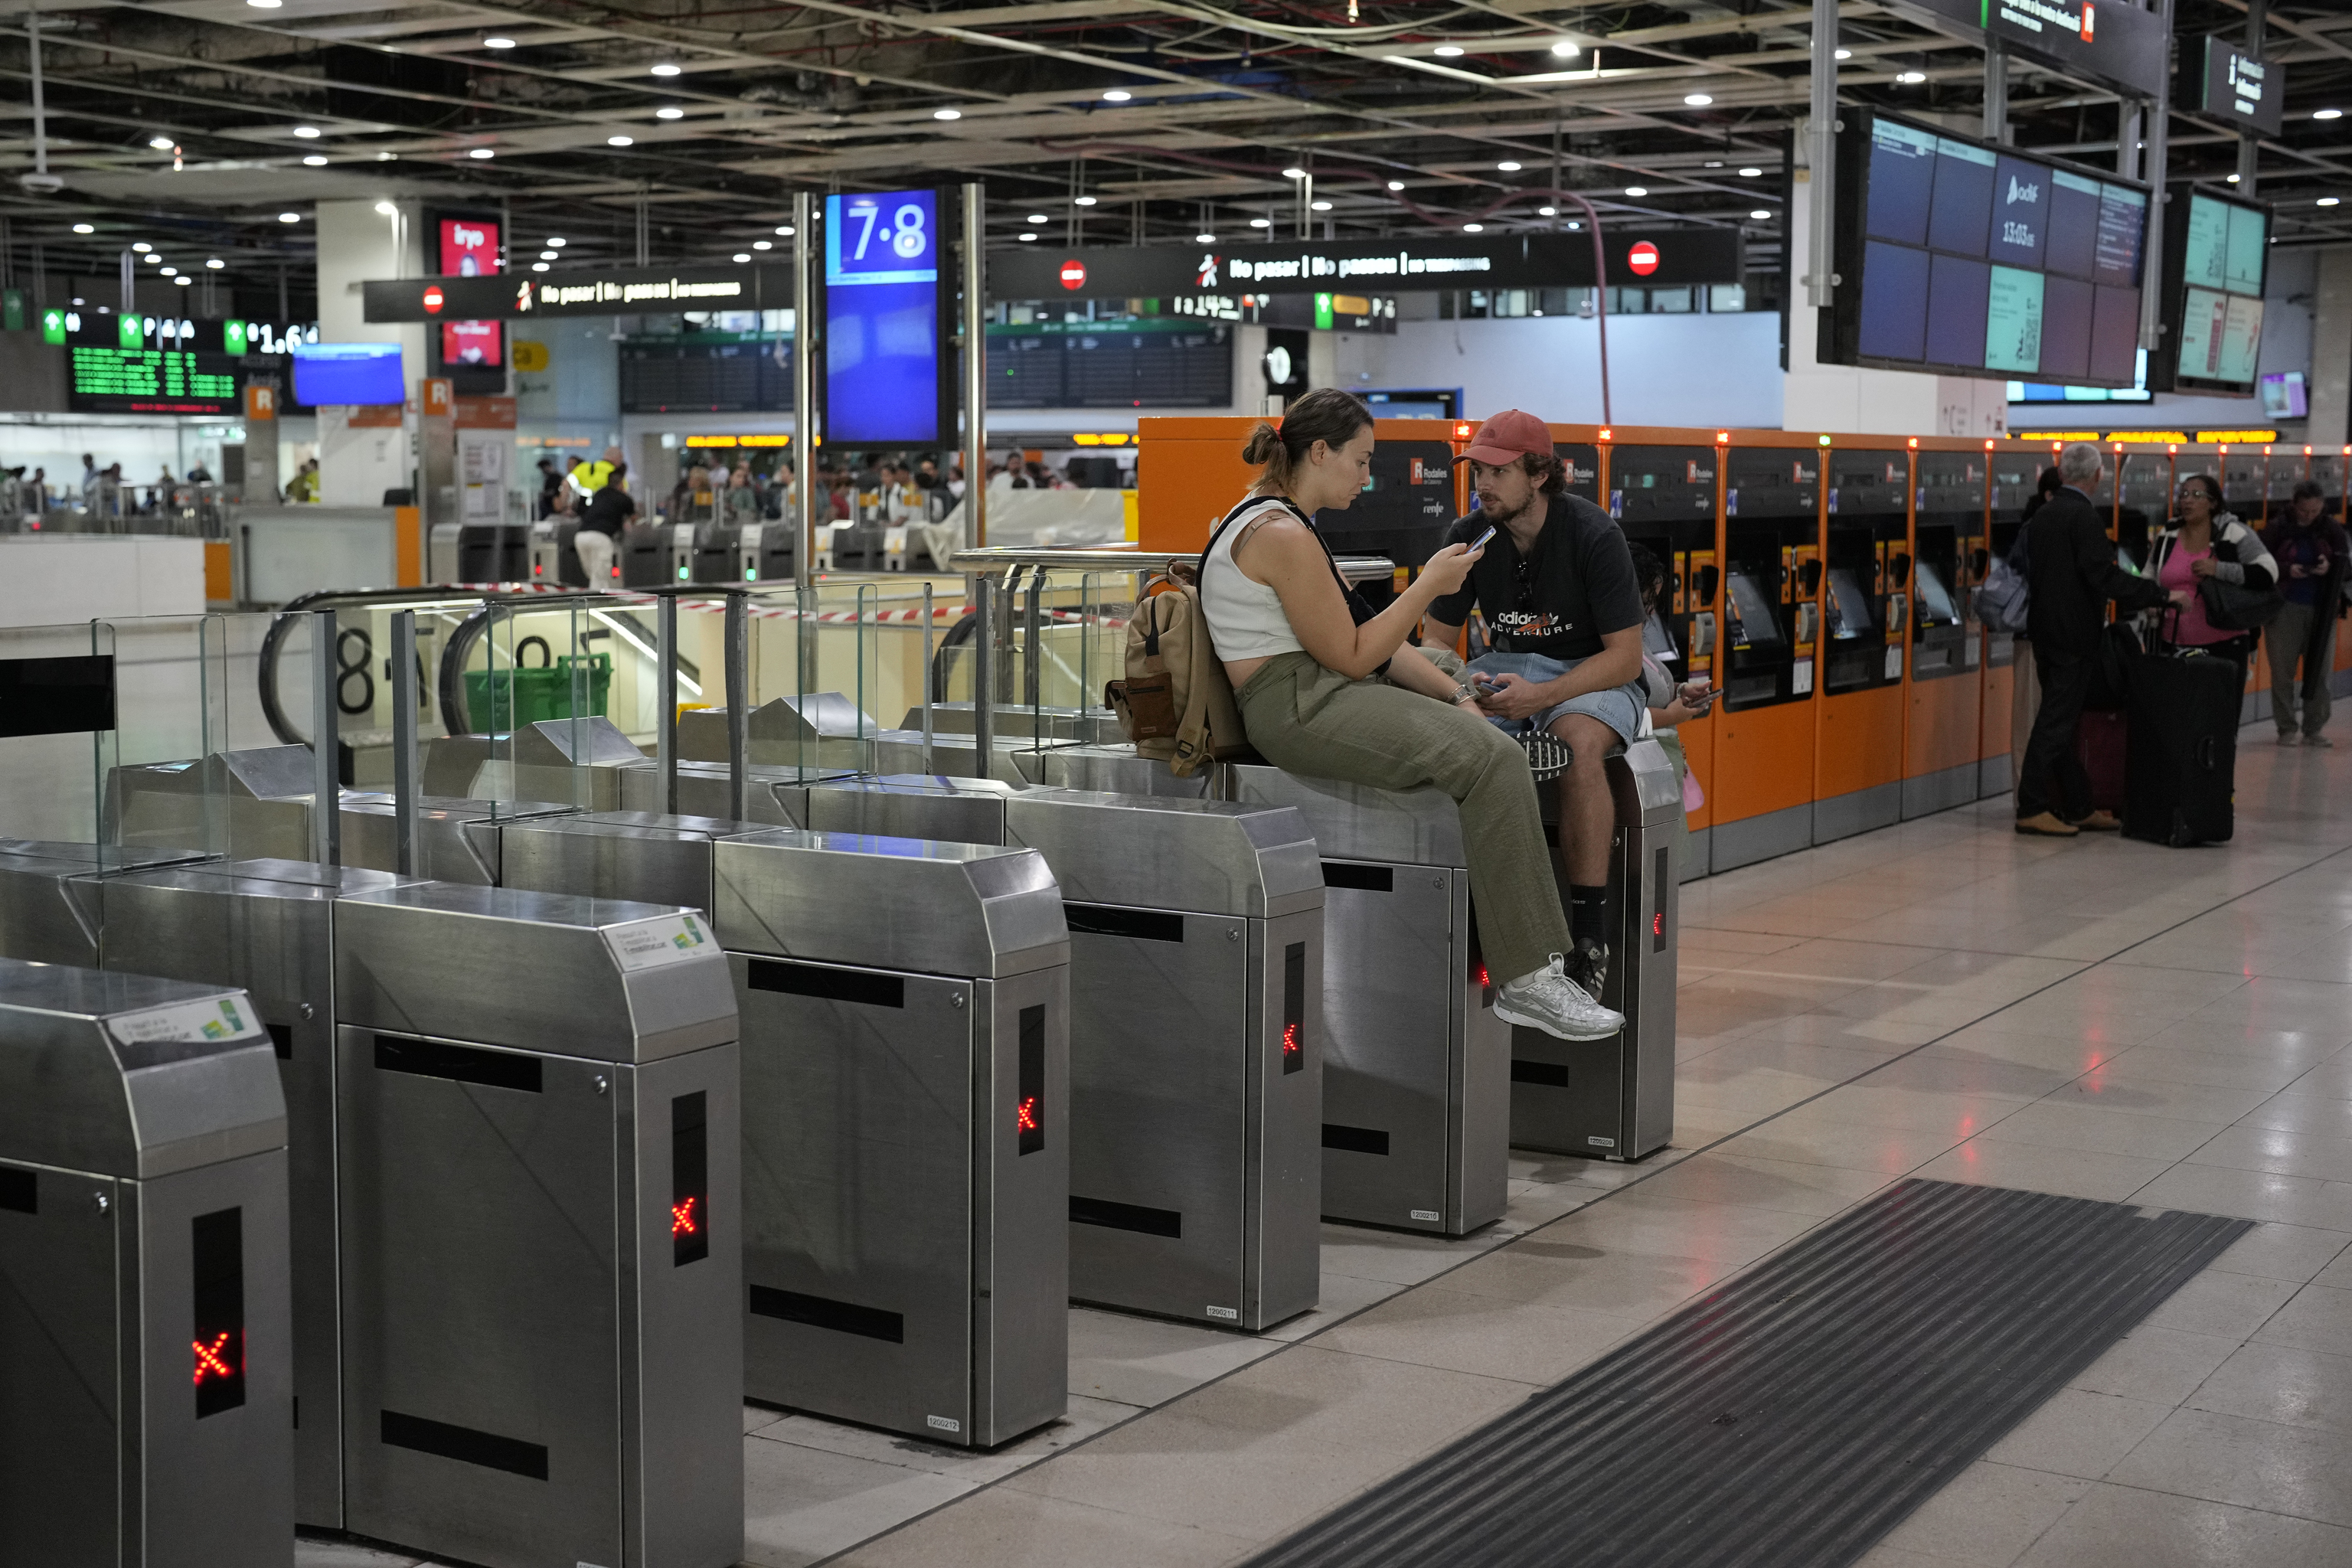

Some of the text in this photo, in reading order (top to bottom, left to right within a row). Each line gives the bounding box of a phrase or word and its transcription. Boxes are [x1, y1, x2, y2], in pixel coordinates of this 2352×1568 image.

[1230, 259, 1253, 278] No
[1254, 260, 1300, 281] pasar
[1312, 256, 1336, 276] No
[256, 389, 273, 410] R
[432, 382, 447, 404] R
[1414, 462, 1447, 479] R Rodalies
[1566, 462, 1573, 477] R
[1423, 501, 1444, 518] renfe
[1412, 1210, 1437, 1220] 1200210
[1208, 1308, 1234, 1317] 1200211
[929, 1417, 957, 1429] 1200212
